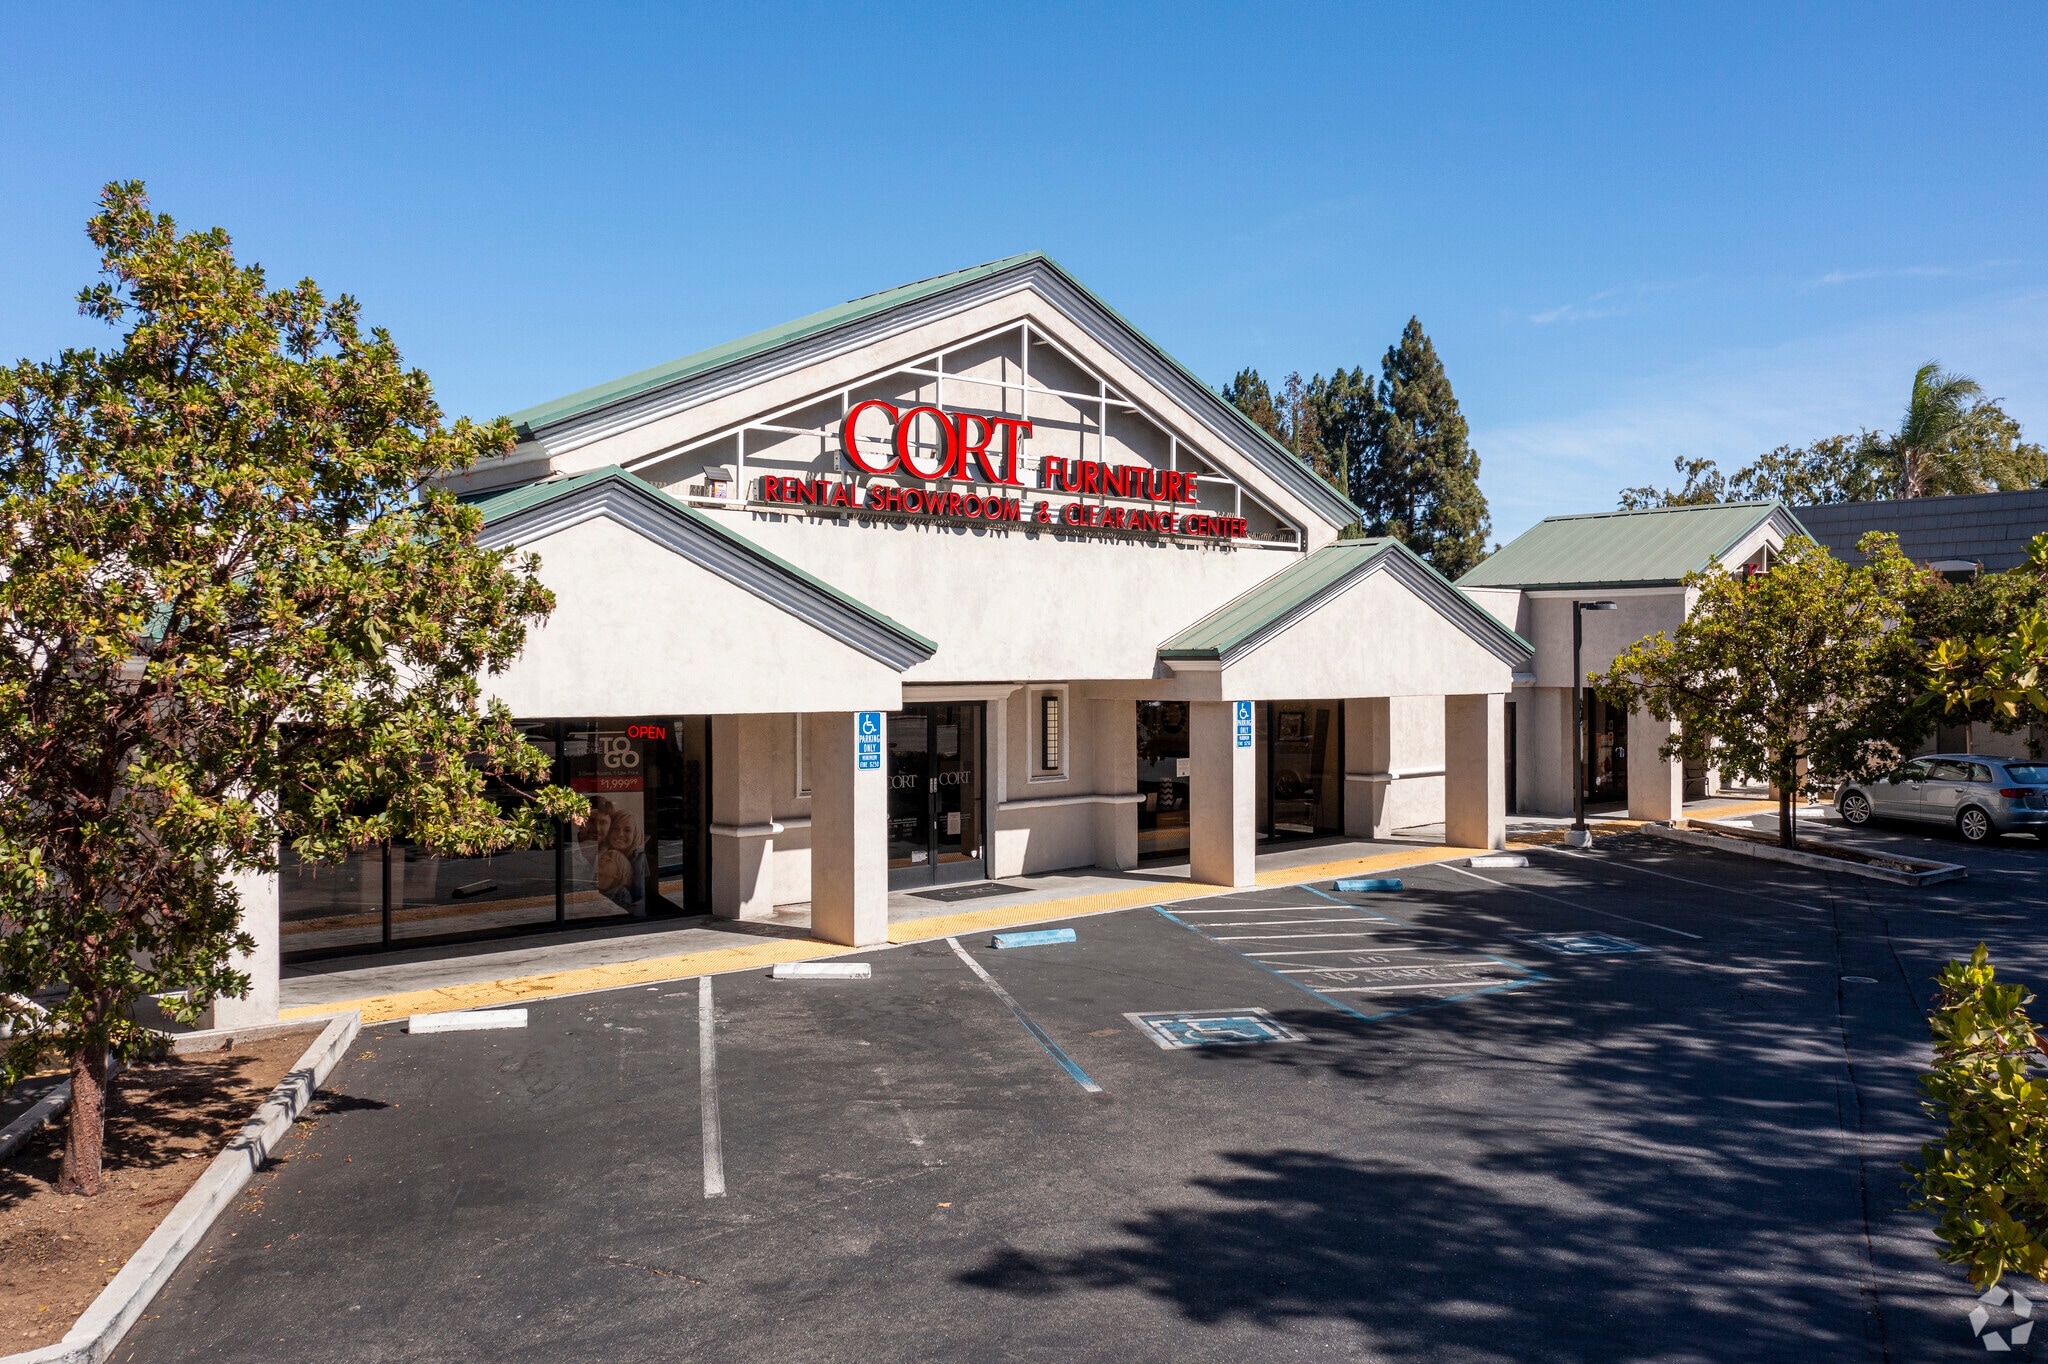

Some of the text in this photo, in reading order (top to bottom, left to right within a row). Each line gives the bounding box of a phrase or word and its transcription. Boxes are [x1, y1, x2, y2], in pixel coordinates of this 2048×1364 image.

[842, 399, 1198, 505] CORT FURNITURE
[765, 475, 1248, 539] RENTAL SHOWROOM & CLEARANCE CENTER
[627, 725, 667, 740] OPEN
[859, 734, 881, 744] PARKING
[599, 736, 631, 754] TO
[863, 743, 877, 753] ONLY
[603, 750, 640, 768] GO
[939, 771, 971, 786] CORT
[1347, 955, 1391, 965] NO
